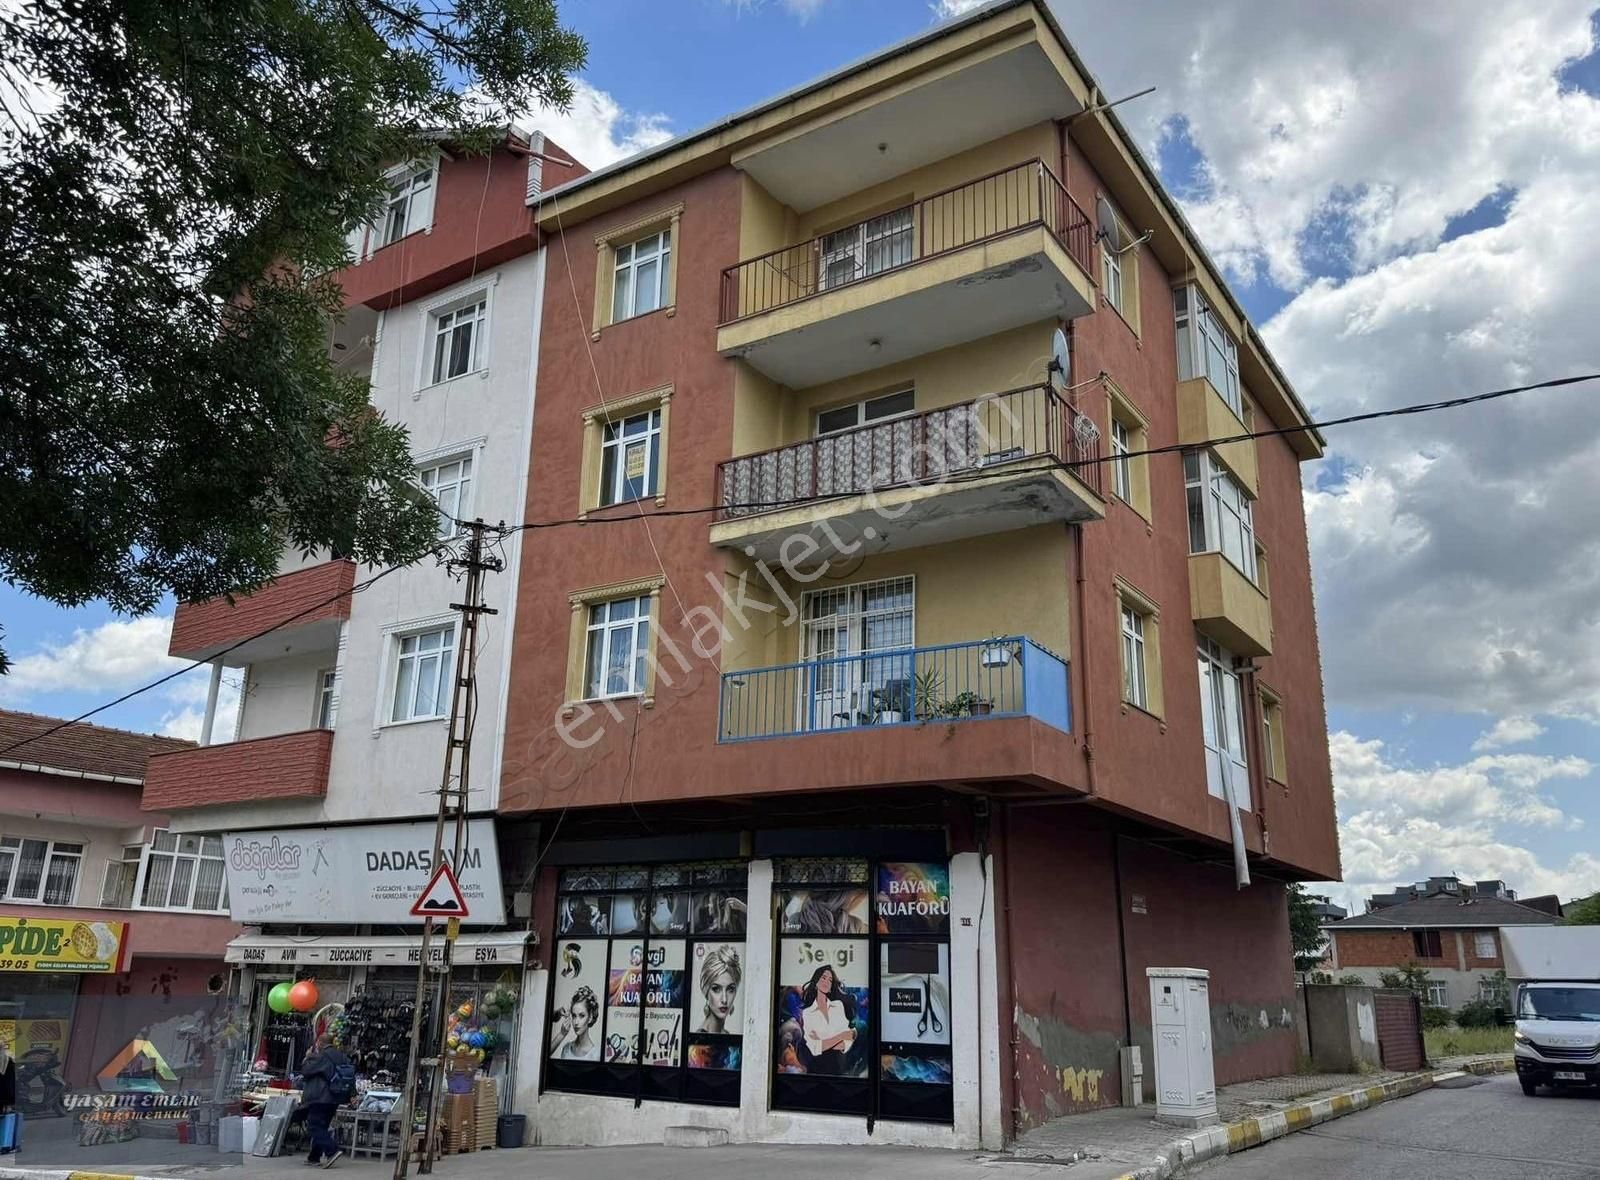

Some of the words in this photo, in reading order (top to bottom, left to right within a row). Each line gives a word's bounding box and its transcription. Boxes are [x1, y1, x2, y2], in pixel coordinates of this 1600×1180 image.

[366, 850, 432, 875] DADAŞ
[889, 880, 939, 894] BAYAN
[878, 896, 950, 916] KUAFÖRÜ
[63, 938, 71, 947] 2
[243, 949, 266, 962] DADAŞ
[281, 949, 297, 961] AVM
[475, 947, 497, 961] EŞYA
[15, 960, 29, 969] 05
[620, 989, 671, 1004] KUAÖRÜ
